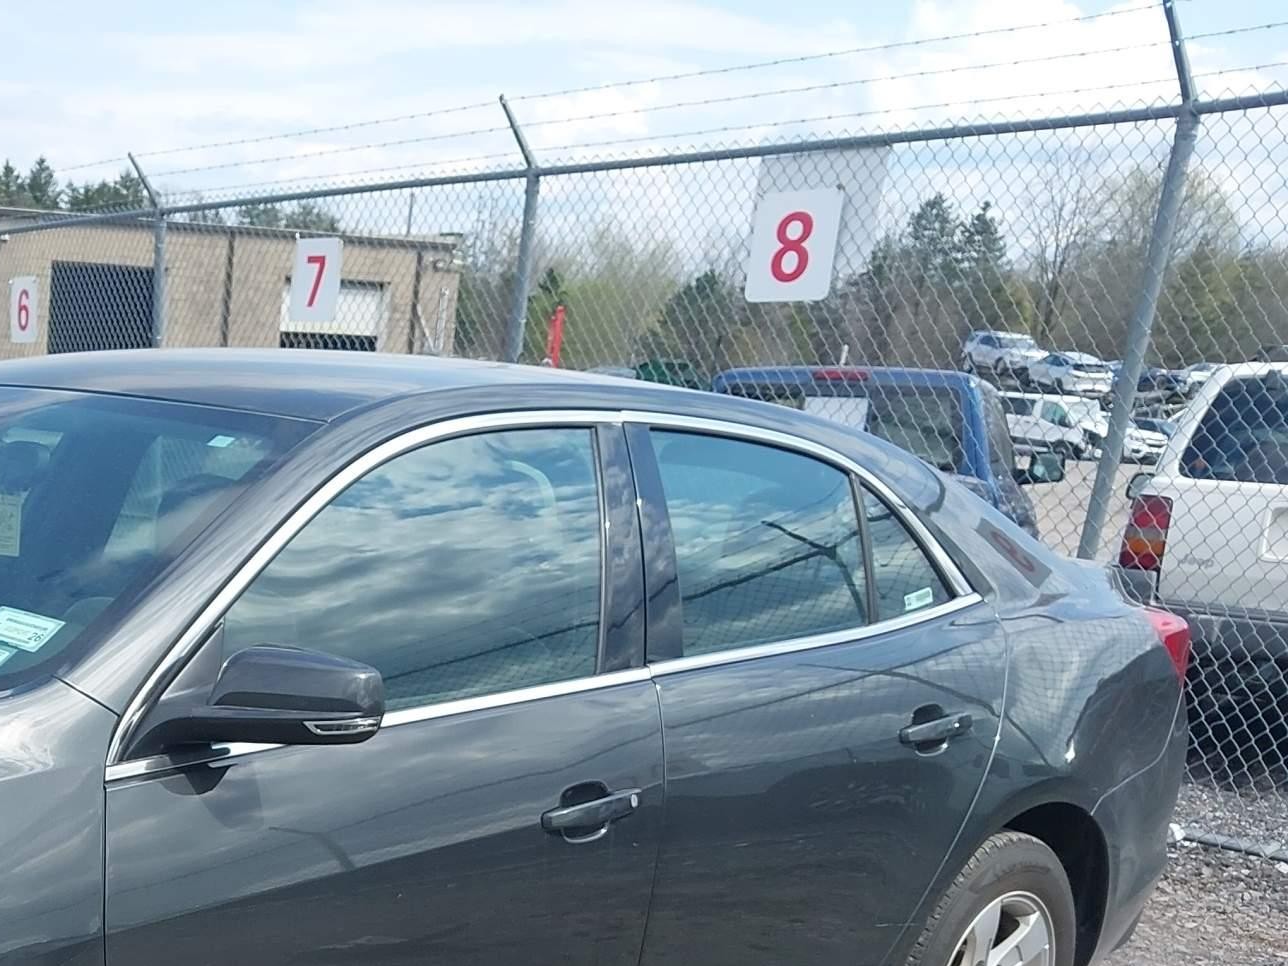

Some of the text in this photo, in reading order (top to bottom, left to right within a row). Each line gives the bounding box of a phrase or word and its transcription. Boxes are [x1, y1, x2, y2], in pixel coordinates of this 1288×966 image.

[770, 211, 814, 283] 8
[307, 255, 326, 307] 7
[18, 288, 29, 331] 6
[27, 632, 45, 642] 26
